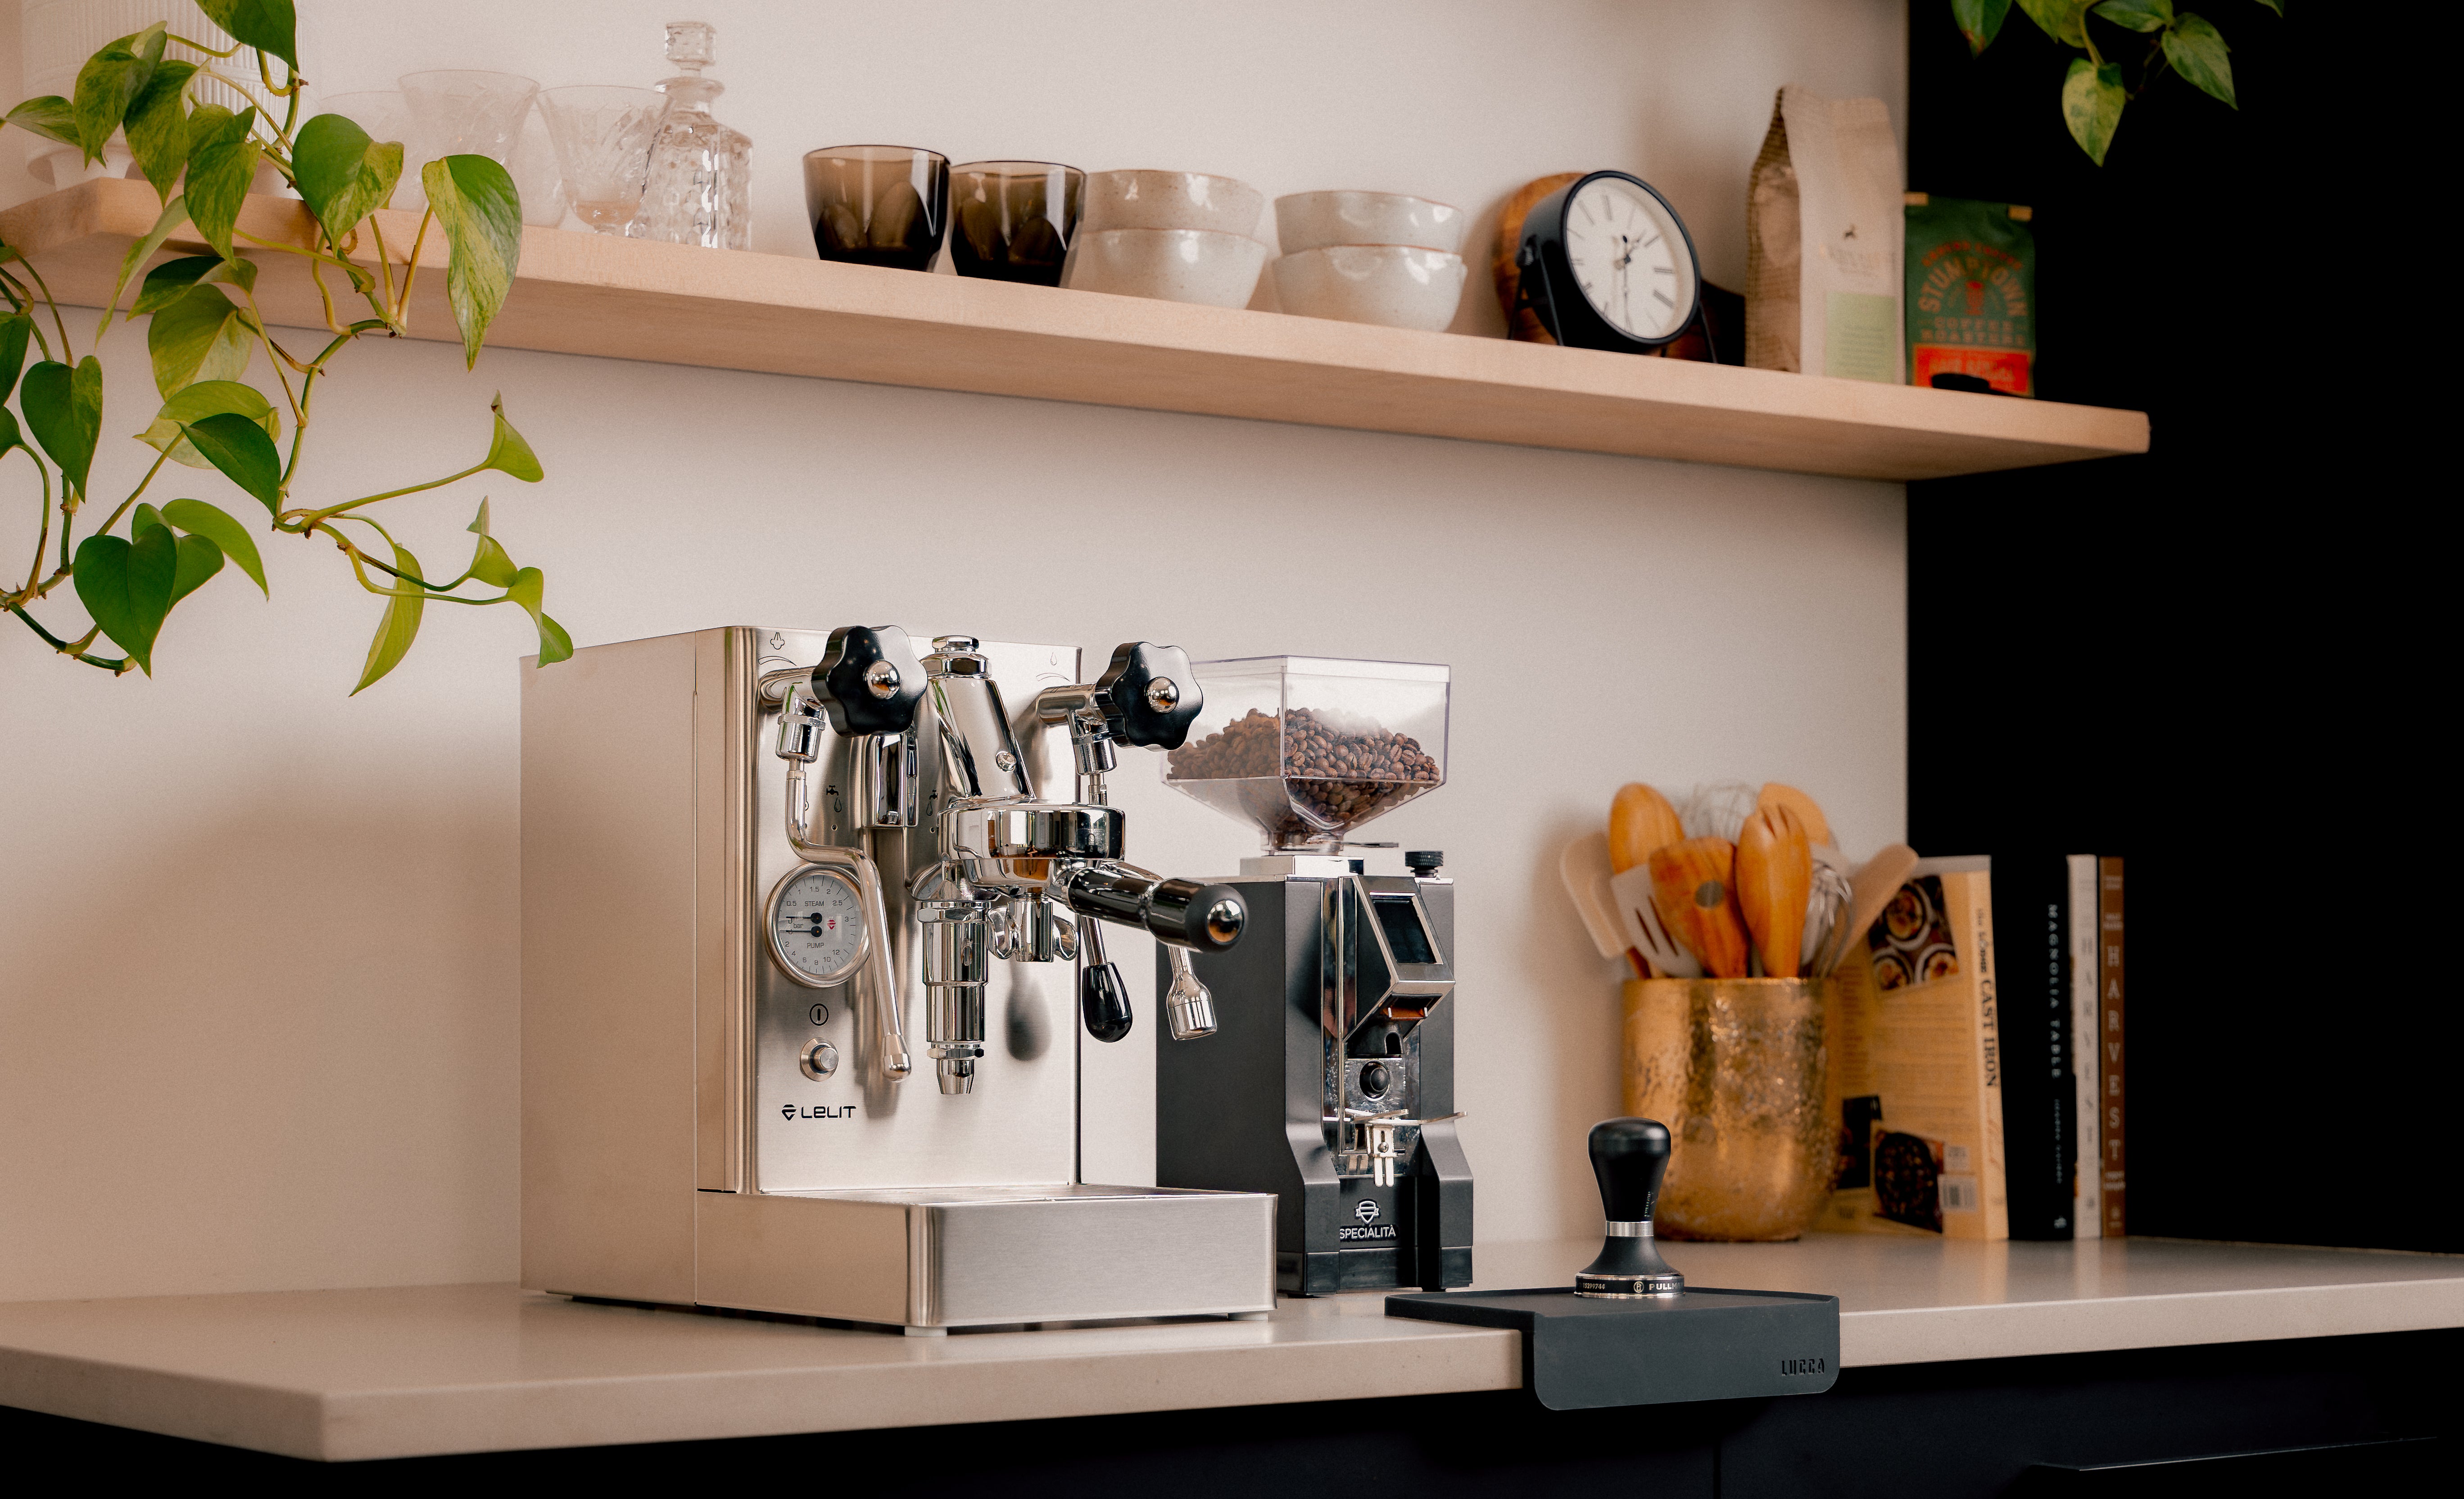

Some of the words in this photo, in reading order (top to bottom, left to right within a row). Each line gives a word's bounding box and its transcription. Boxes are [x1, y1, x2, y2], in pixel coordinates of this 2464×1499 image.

[1918, 257, 2028, 317] STUMPTOWN
[1935, 317, 2013, 332] COFFEE
[2048, 904, 2060, 1009] MAGNOLIA
[1980, 980, 1995, 1030] CAST
[1984, 1037, 1997, 1088] IRON
[2049, 1019, 2062, 1079] TABLE
[2107, 945, 2121, 1161] HARVEST
[1340, 1225, 1396, 1239] SPECIALITÀ
[1781, 1358, 1825, 1376] LUCCA
